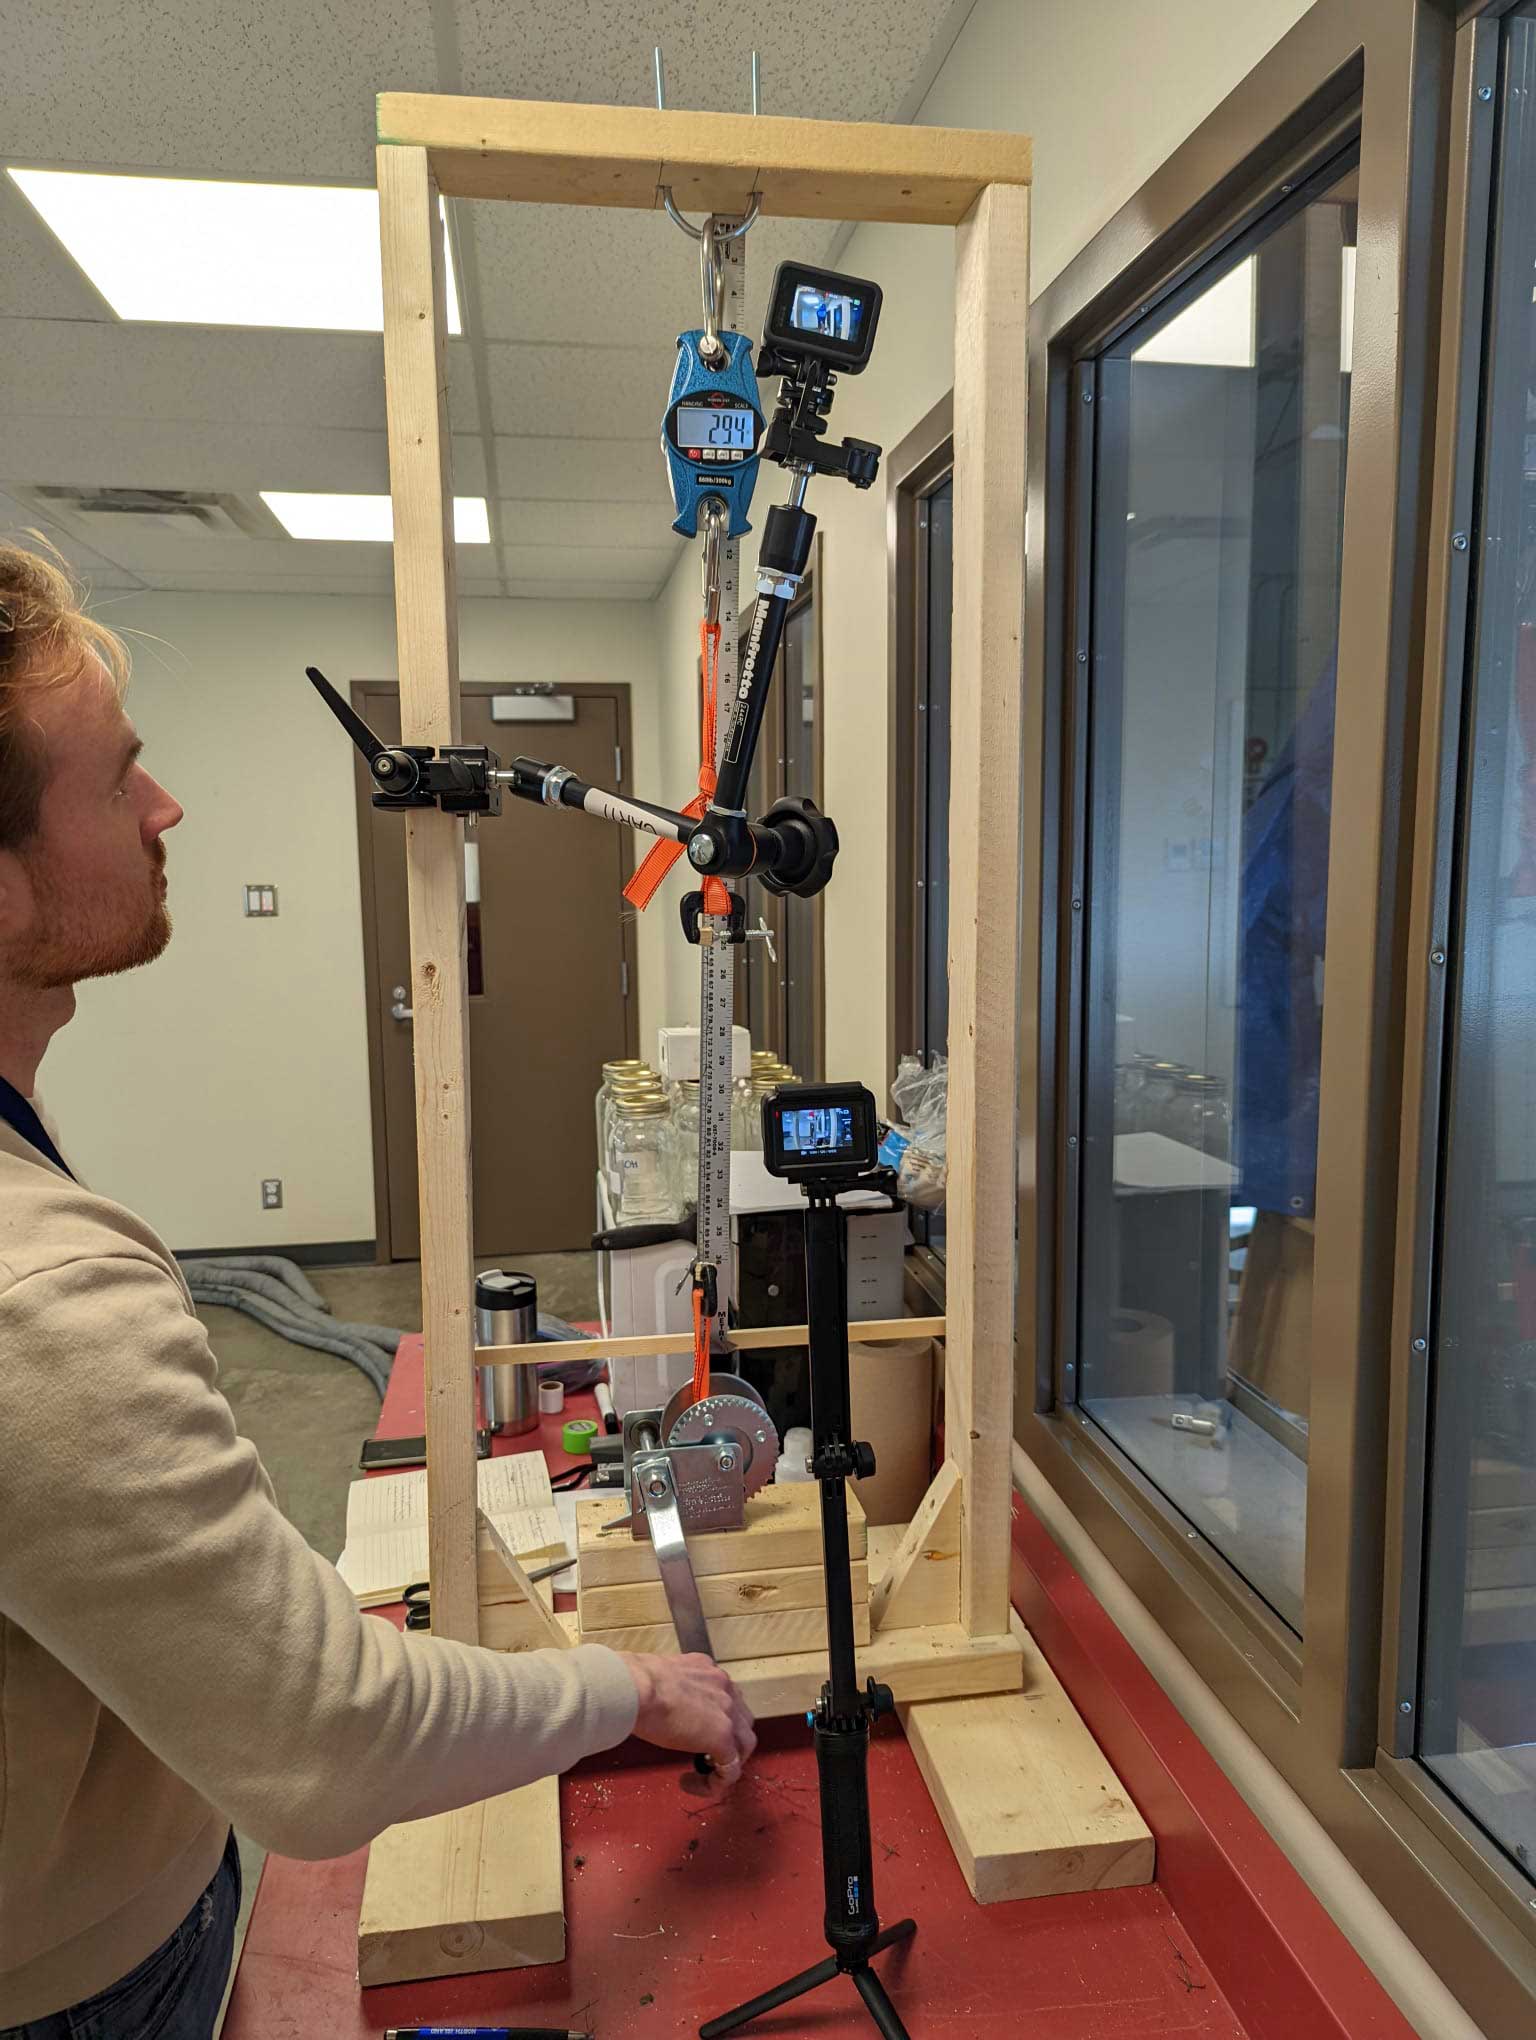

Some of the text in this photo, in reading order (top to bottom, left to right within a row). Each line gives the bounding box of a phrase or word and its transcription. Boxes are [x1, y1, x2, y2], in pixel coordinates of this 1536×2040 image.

[726, 549, 733, 560] 12
[726, 580, 732, 591] 13
[725, 611, 731, 621] 14
[725, 642, 731, 652] 15
[738, 599, 770, 700] Manfrotto
[724, 673, 730, 684] 16
[724, 702, 730, 713] 17
[737, 703, 747, 727] 244RC
[720, 941, 727, 951] 25
[720, 969, 726, 979] 26
[720, 998, 726, 1008] 27
[720, 1026, 725, 1036] 28
[719, 1056, 725, 1065] 29
[719, 1084, 724, 1094] 30
[718, 1112, 724, 1121] 31
[718, 1141, 723, 1151] 32
[717, 1169, 723, 1179] 33
[717, 1198, 723, 1208] 34
[716, 1226, 722, 1236] 35
[716, 1255, 721, 1264] 36
[718, 1311, 726, 1341] METRI
[847, 1876, 855, 1915] GoPro
